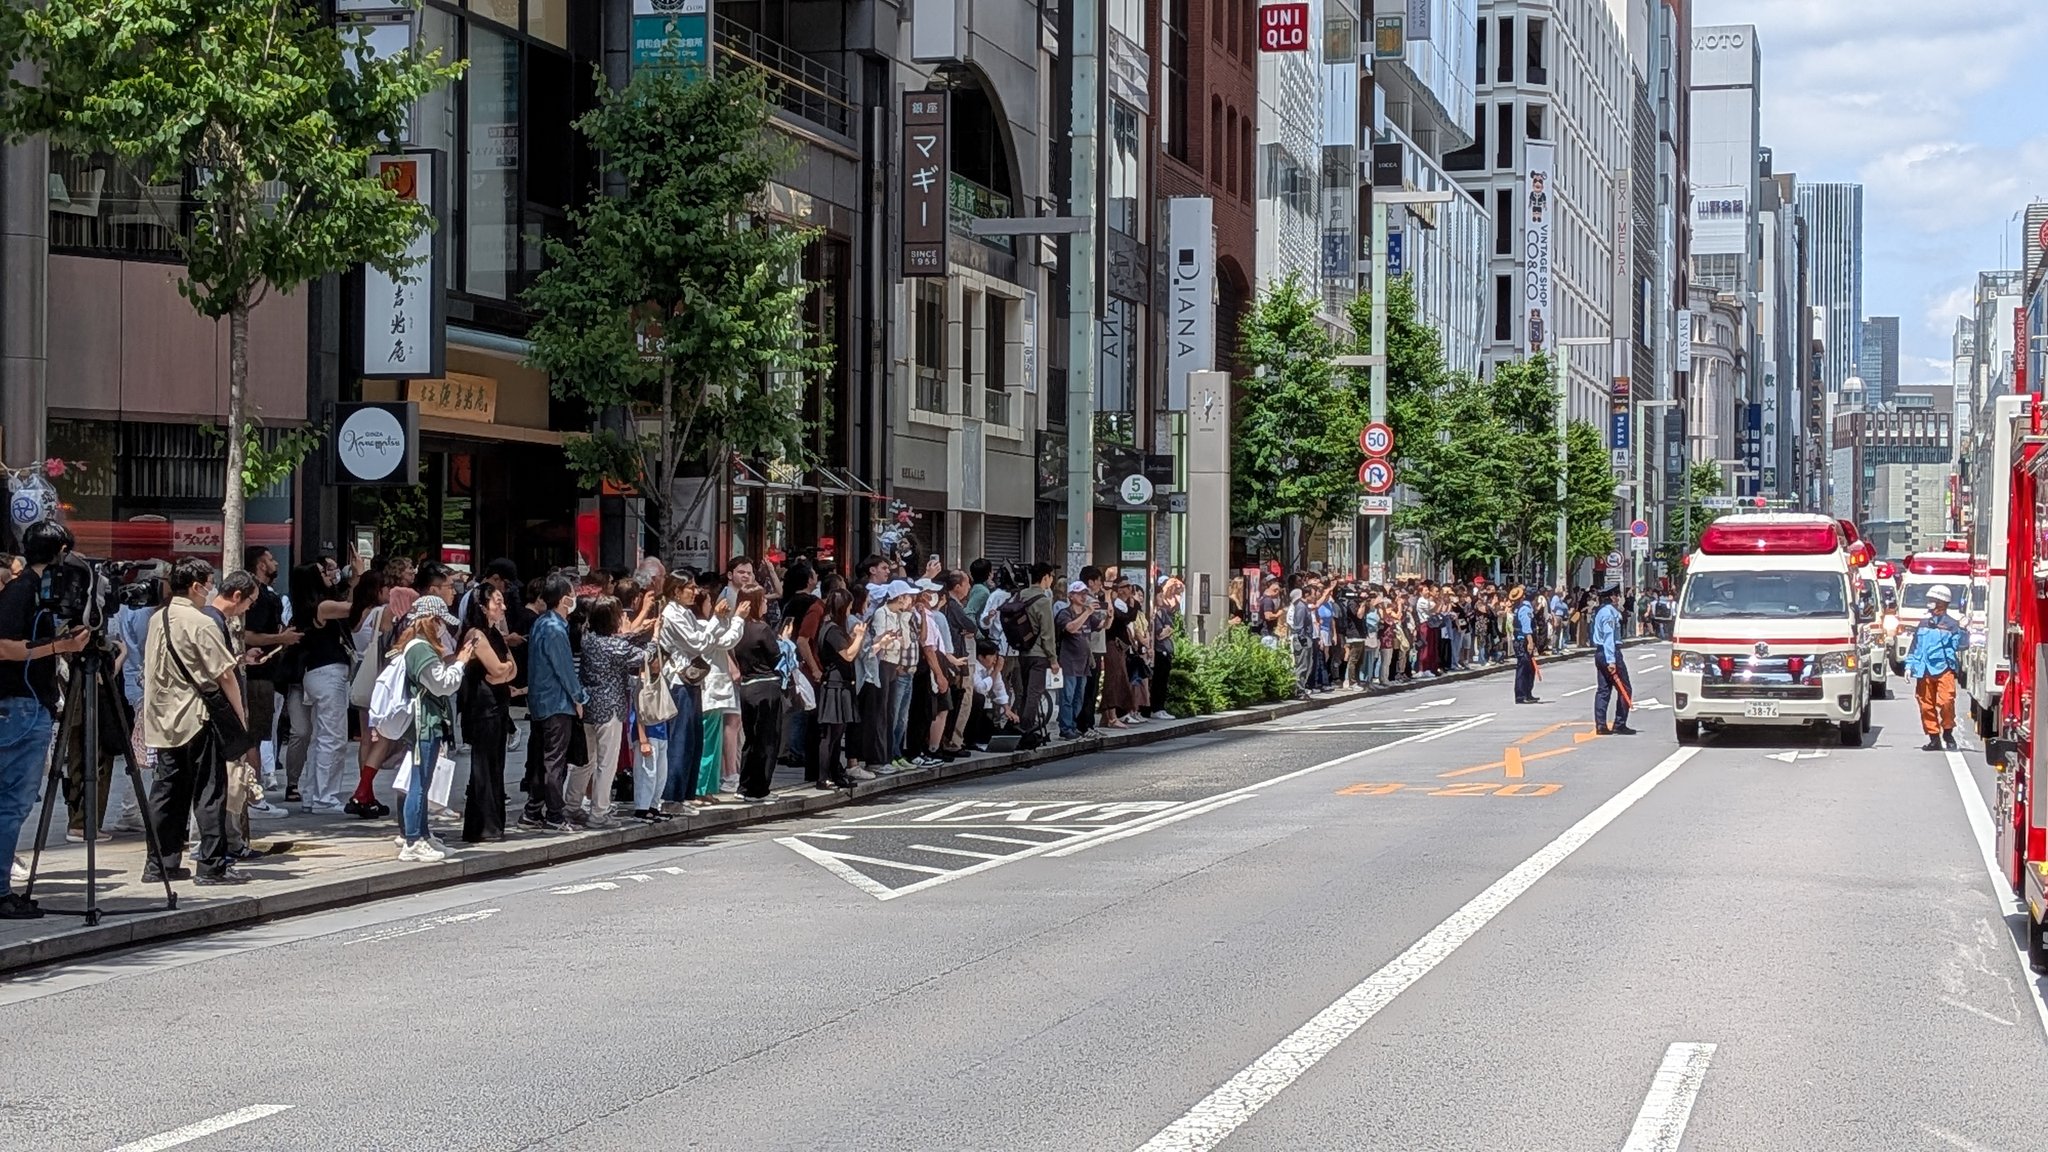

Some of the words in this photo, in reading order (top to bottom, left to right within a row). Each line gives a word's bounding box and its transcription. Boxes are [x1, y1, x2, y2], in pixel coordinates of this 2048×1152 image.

[1267, 9, 1300, 26] UNI
[1266, 28, 1303, 48] QLO
[912, 102, 938, 114] 銀座
[912, 135, 939, 227] マギー
[911, 250, 937, 258] SINCE
[1538, 224, 1549, 273] VINTAGE
[1526, 230, 1540, 301] CO&CO
[1538, 276, 1548, 308] SHOP
[1173, 249, 1200, 358] DIANA
[1680, 317, 1688, 365] TASAKI
[2016, 312, 2026, 371] MITSUKOSHI
[1368, 432, 1386, 447] 50
[1131, 478, 1141, 492] 5
[1655, 551, 1668, 559] GU
[1752, 707, 1777, 716] 38-76
